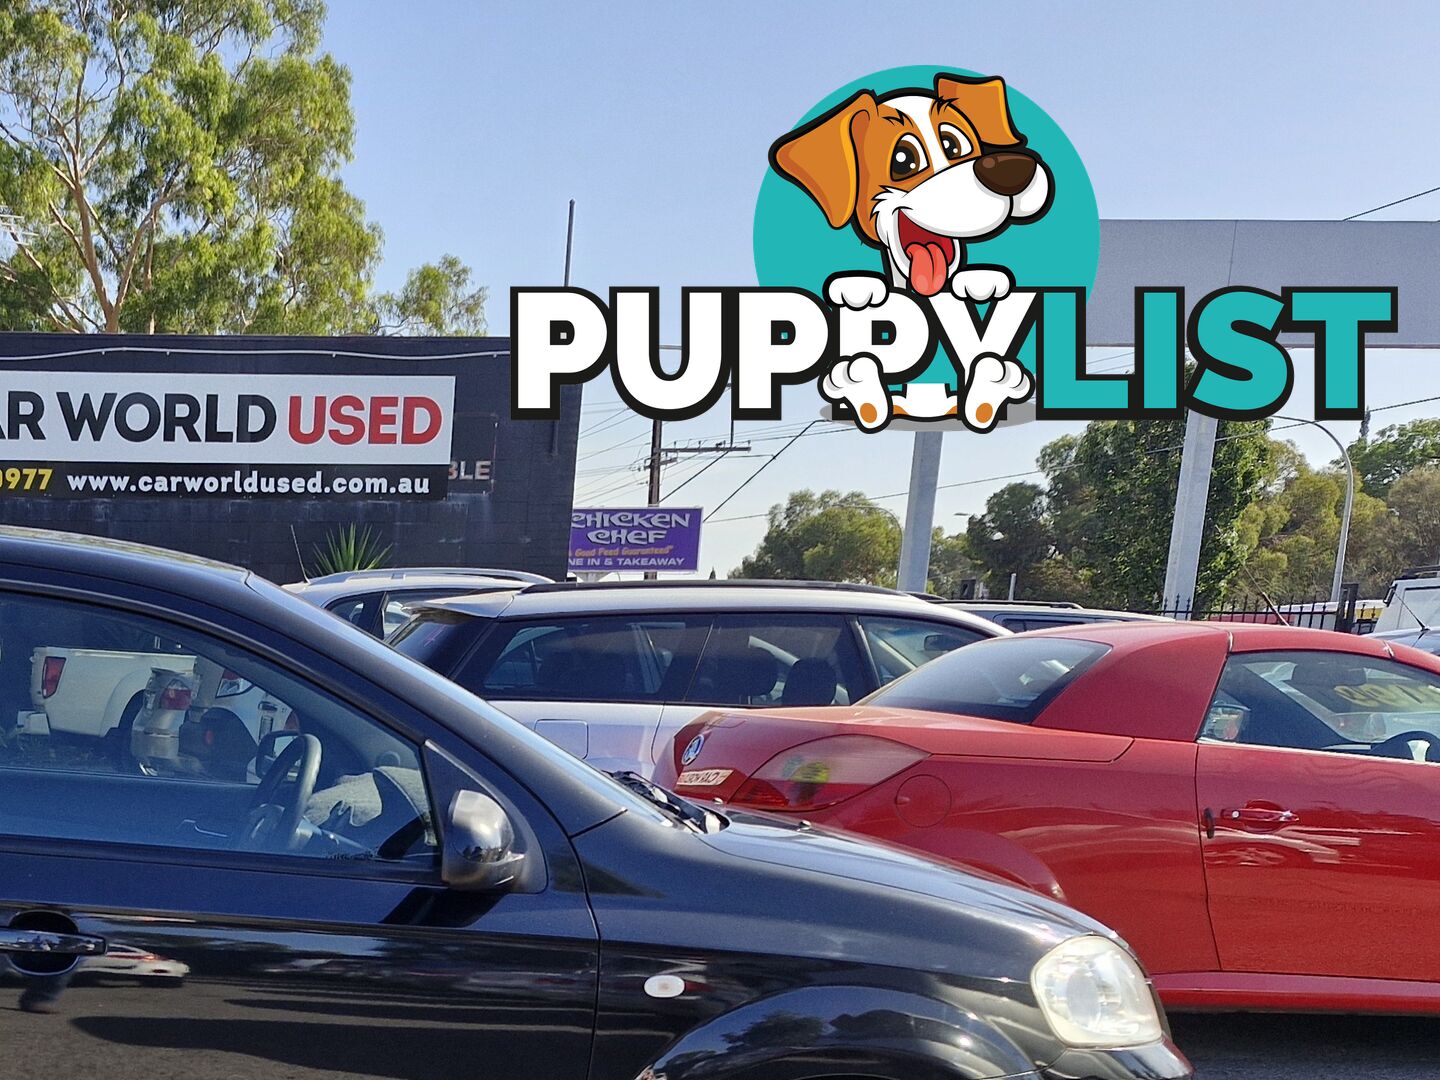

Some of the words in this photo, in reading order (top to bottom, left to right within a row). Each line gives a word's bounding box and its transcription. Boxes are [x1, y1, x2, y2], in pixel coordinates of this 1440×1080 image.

[56, 391, 278, 444] WORLD
[287, 394, 443, 446] USED
[66, 470, 430, 495] www.carworldused.com.au
[587, 558, 600, 566] IN
[617, 558, 685, 566] TAKEAWAY
